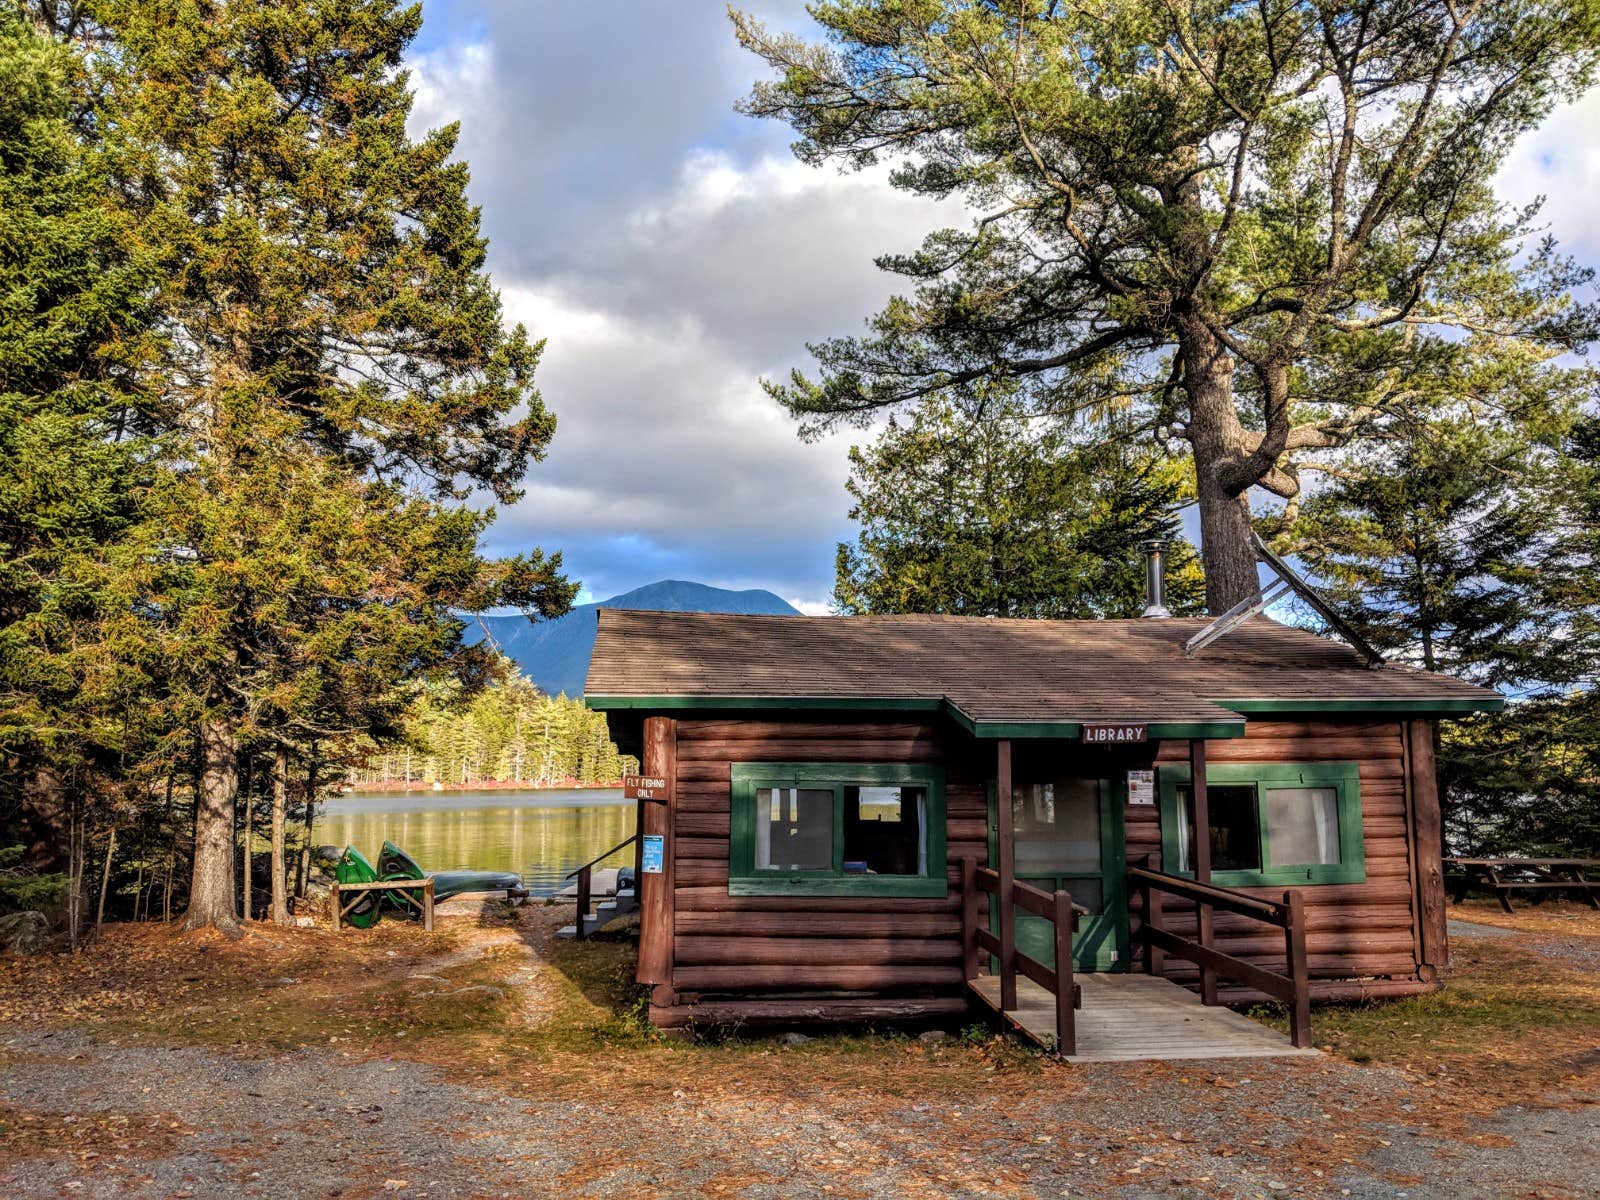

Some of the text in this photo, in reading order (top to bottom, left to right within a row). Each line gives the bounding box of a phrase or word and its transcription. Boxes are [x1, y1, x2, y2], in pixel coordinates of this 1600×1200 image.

[1087, 728, 1143, 741] LIBRARY
[627, 778, 665, 788] FLY FISHING
[637, 789, 653, 798] ONLY
